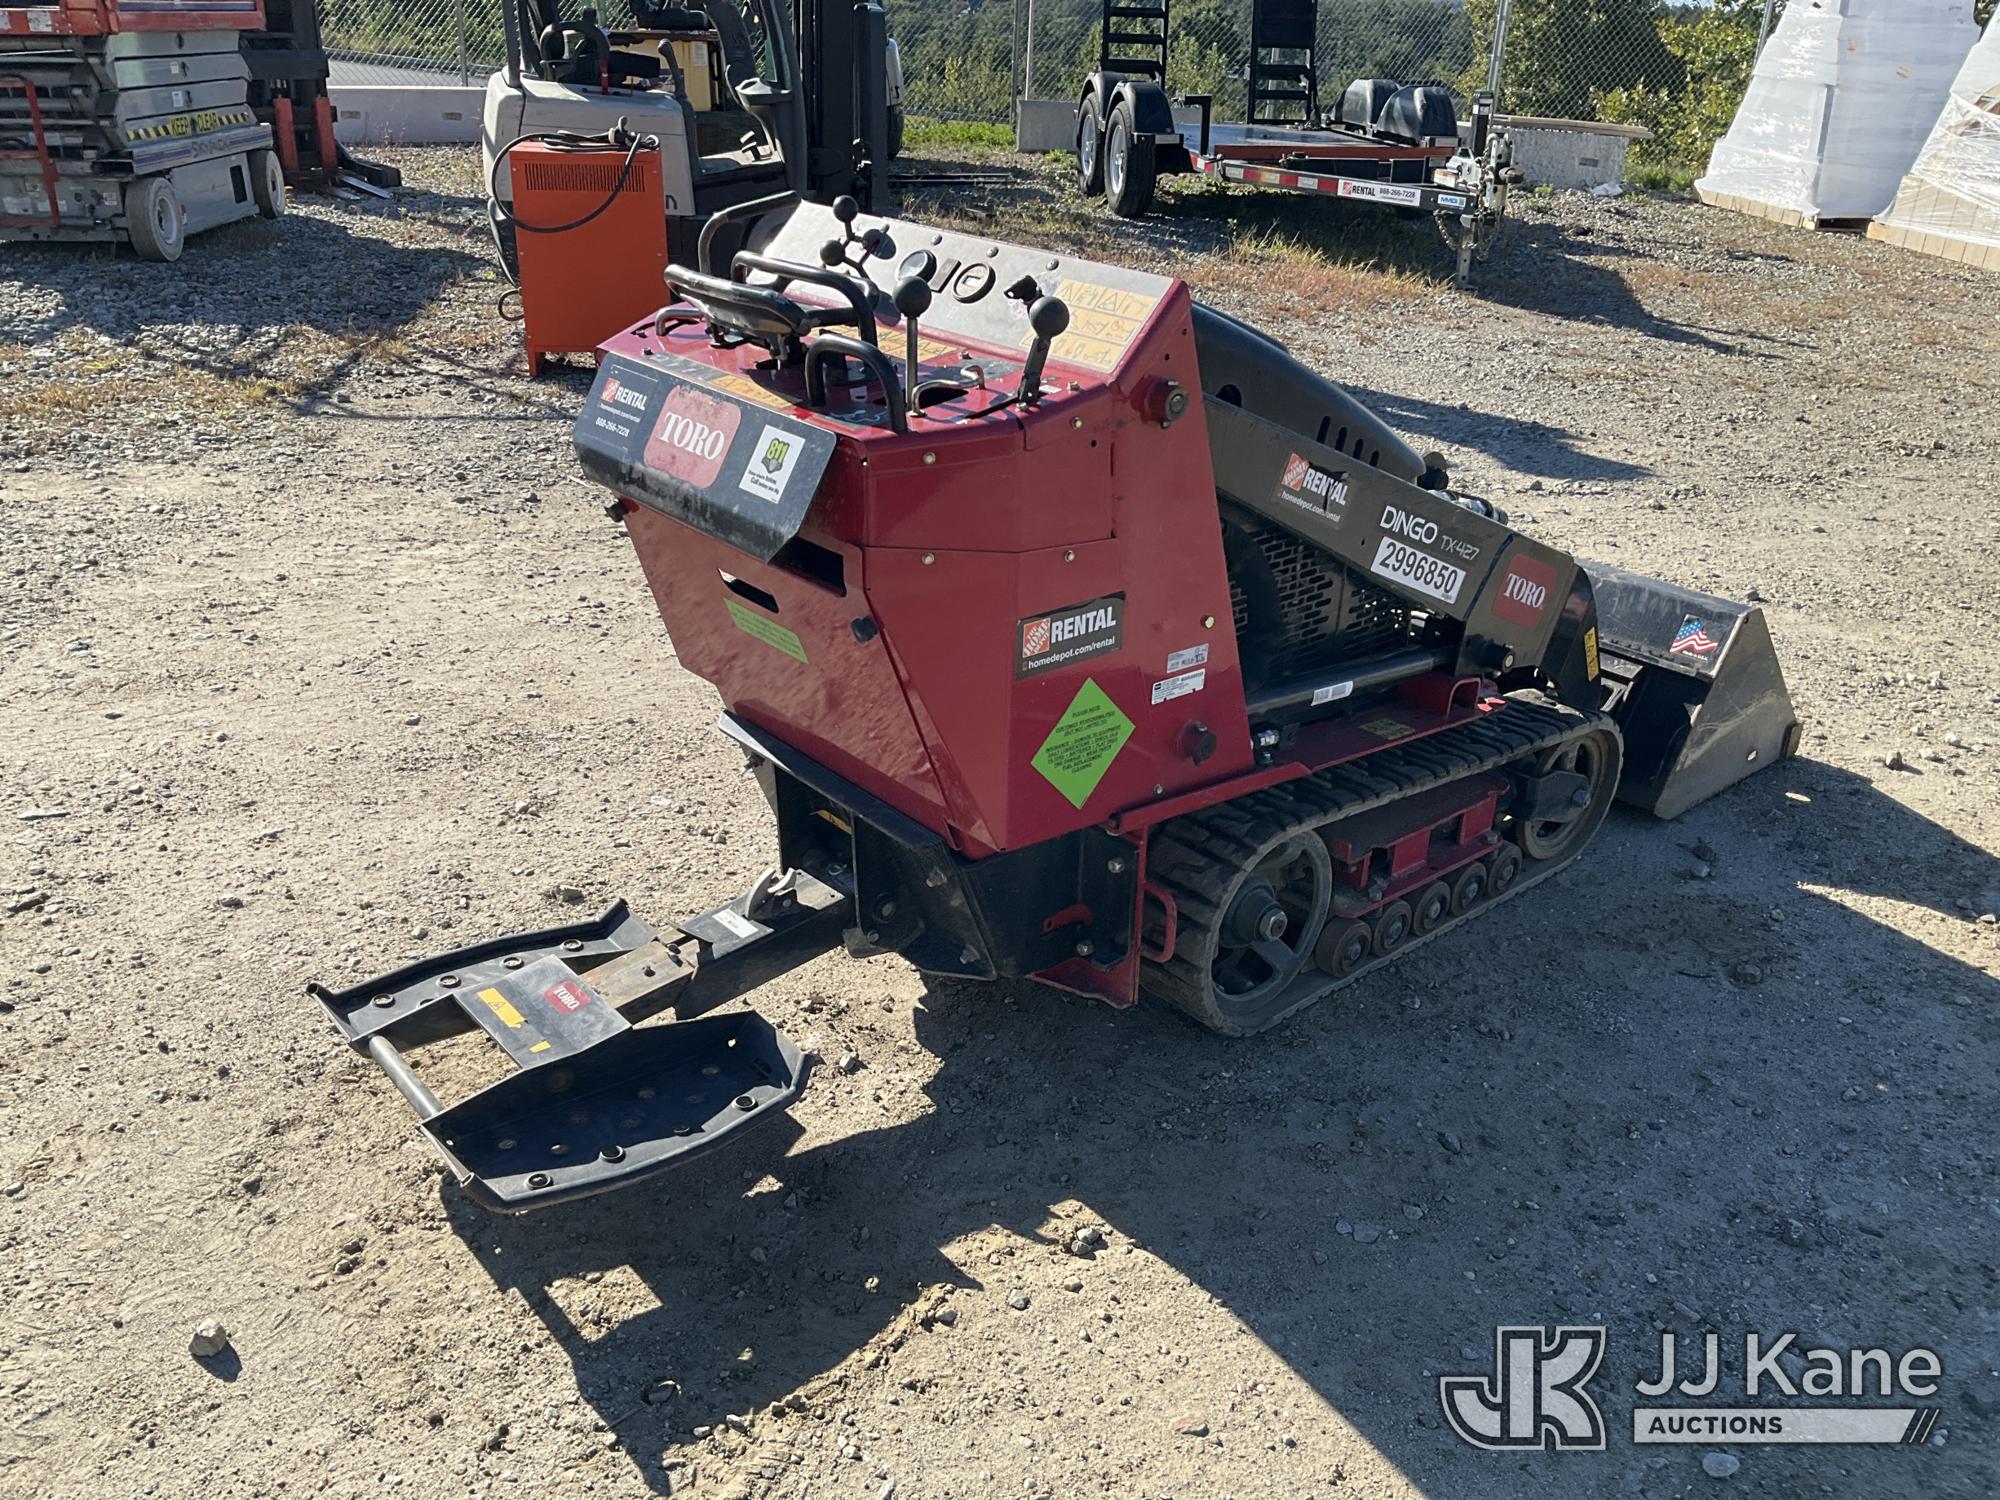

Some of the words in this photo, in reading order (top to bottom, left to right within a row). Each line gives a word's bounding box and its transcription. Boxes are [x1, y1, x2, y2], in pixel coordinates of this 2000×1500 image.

[171, 116, 189, 136] KEEP
[196, 112, 217, 132] CLEAR
[1352, 185, 1376, 197] RENTAL
[615, 386, 648, 411] RENTAL
[656, 411, 725, 460] TORO
[766, 439, 790, 464] 811
[1303, 468, 1348, 506] RENTAL
[1380, 505, 1438, 544] DINGO
[1379, 541, 1458, 594] 2996850
[1504, 572, 1546, 608] TORO
[1051, 606, 1117, 644] RENTAL
[1028, 636, 1116, 669] homedepot.com/rental
[552, 985, 580, 1010] TORO
